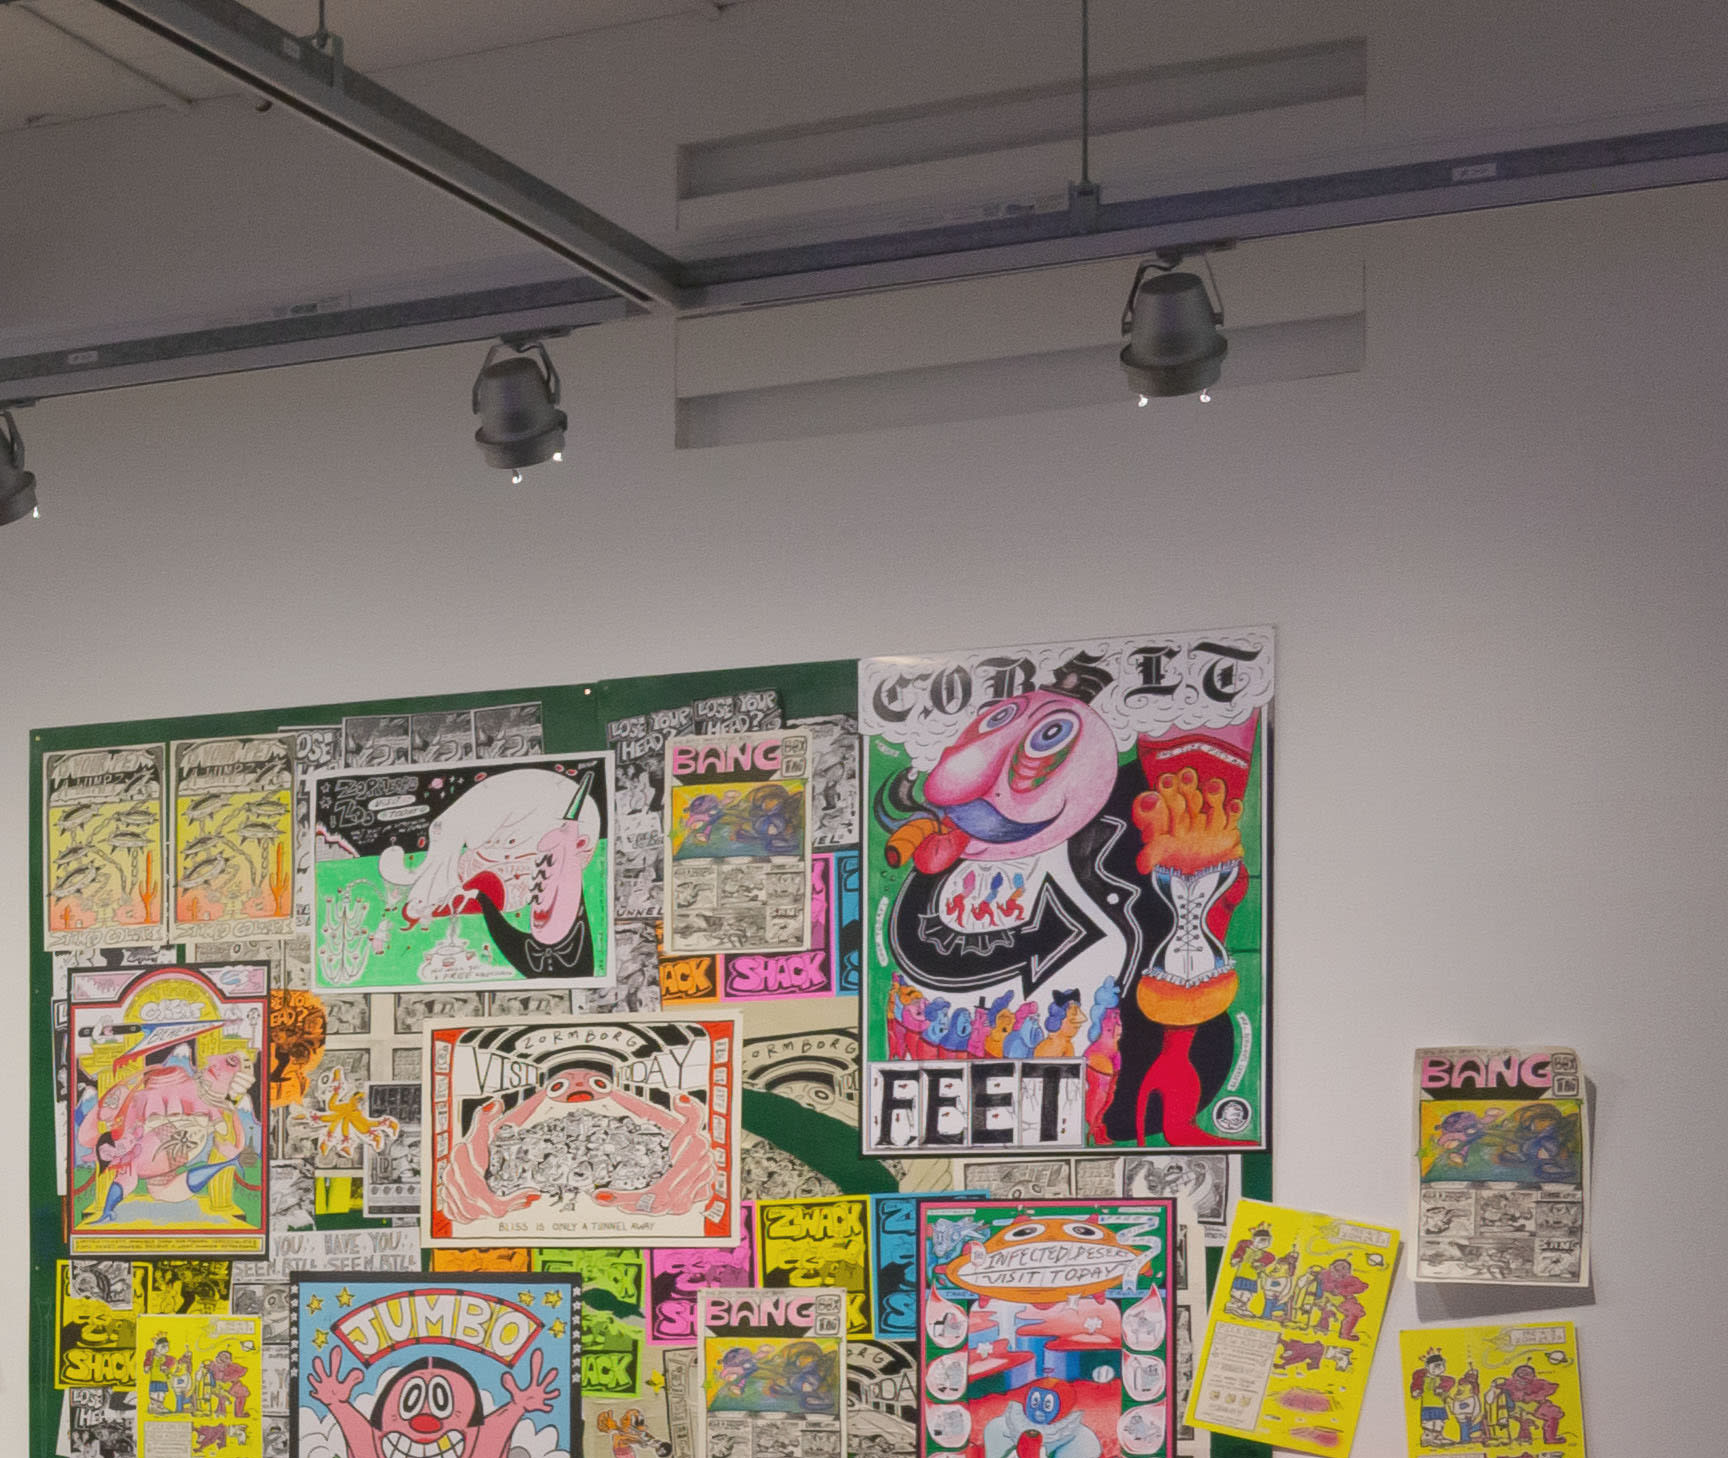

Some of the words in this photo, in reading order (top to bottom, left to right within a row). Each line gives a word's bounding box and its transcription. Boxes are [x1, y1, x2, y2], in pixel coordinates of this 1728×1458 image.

[696, 697, 733, 719] LOSE
[739, 690, 776, 712] YOUR
[611, 716, 646, 738] LOSE
[652, 706, 692, 729] YOUR
[296, 732, 334, 762] OSE
[619, 728, 677, 761] HEAD?
[673, 739, 782, 775] BANG
[616, 906, 663, 918] UNNEL
[660, 956, 712, 993] ACK
[726, 952, 827, 991] SHACK
[523, 1029, 639, 1050] ZORMBORG
[750, 1038, 858, 1062] ORMBORG
[1421, 1053, 1552, 1088] BANG
[876, 1063, 1081, 1146] FEET
[499, 1222, 529, 1232] BLISS
[535, 1222, 545, 1232] IS
[552, 1222, 576, 1232] ONLY
[582, 1222, 589, 1231] A
[766, 1202, 862, 1241] ZWACK
[324, 1233, 361, 1255] HAVE
[985, 1245, 1068, 1269] INFECTED
[983, 1270, 1040, 1285] VISIT
[1051, 1263, 1120, 1284] TODAY
[341, 1294, 528, 1357] JUMBO
[706, 1298, 815, 1327] BANG
[581, 1353, 632, 1389] ACK
